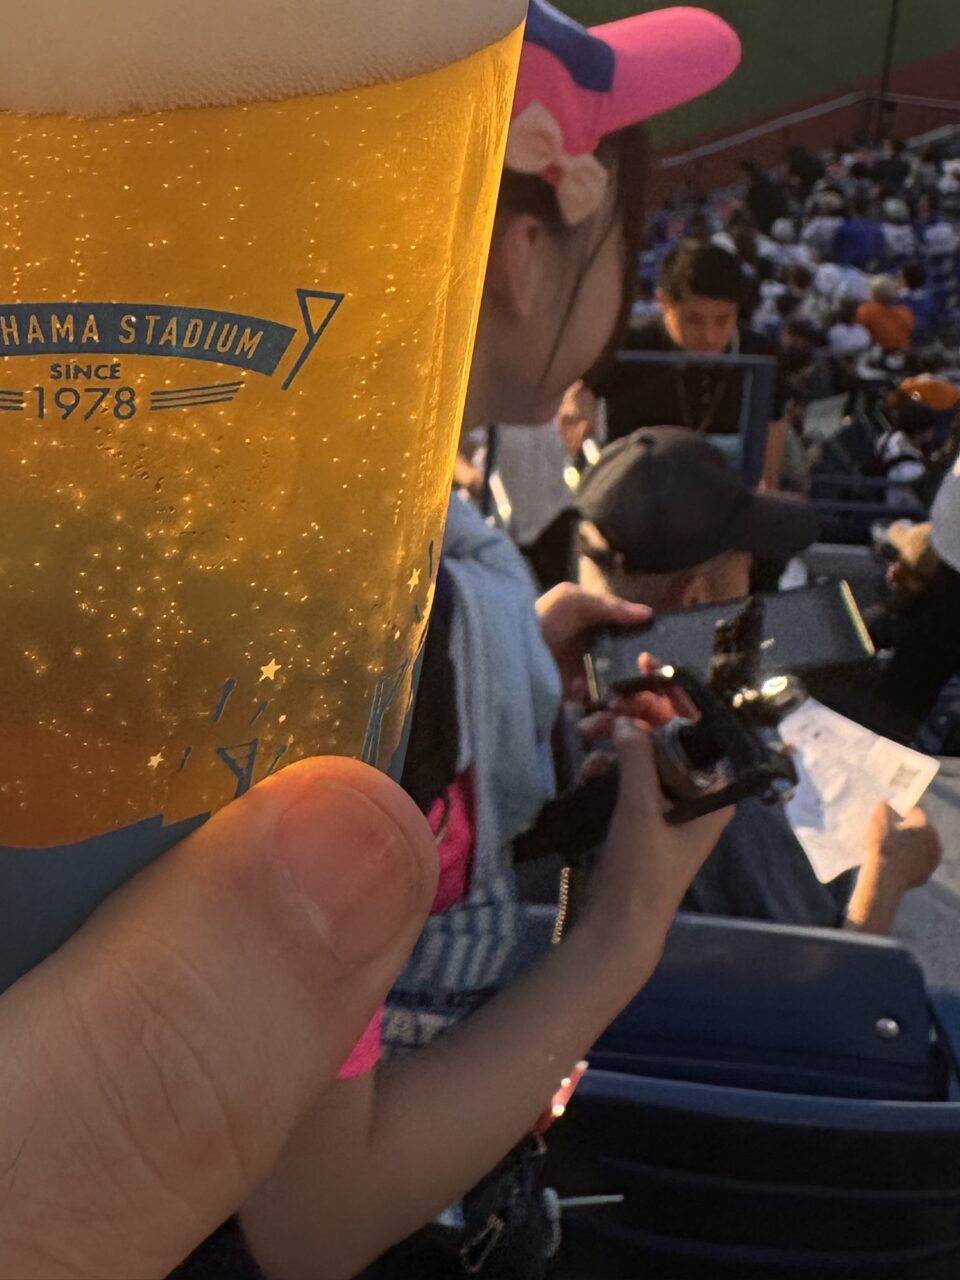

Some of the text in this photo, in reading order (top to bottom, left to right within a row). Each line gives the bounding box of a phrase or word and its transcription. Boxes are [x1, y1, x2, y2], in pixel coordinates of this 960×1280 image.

[118, 313, 265, 360] STADIUM
[50, 362, 121, 381] SINCE
[33, 386, 137, 422] 1978
